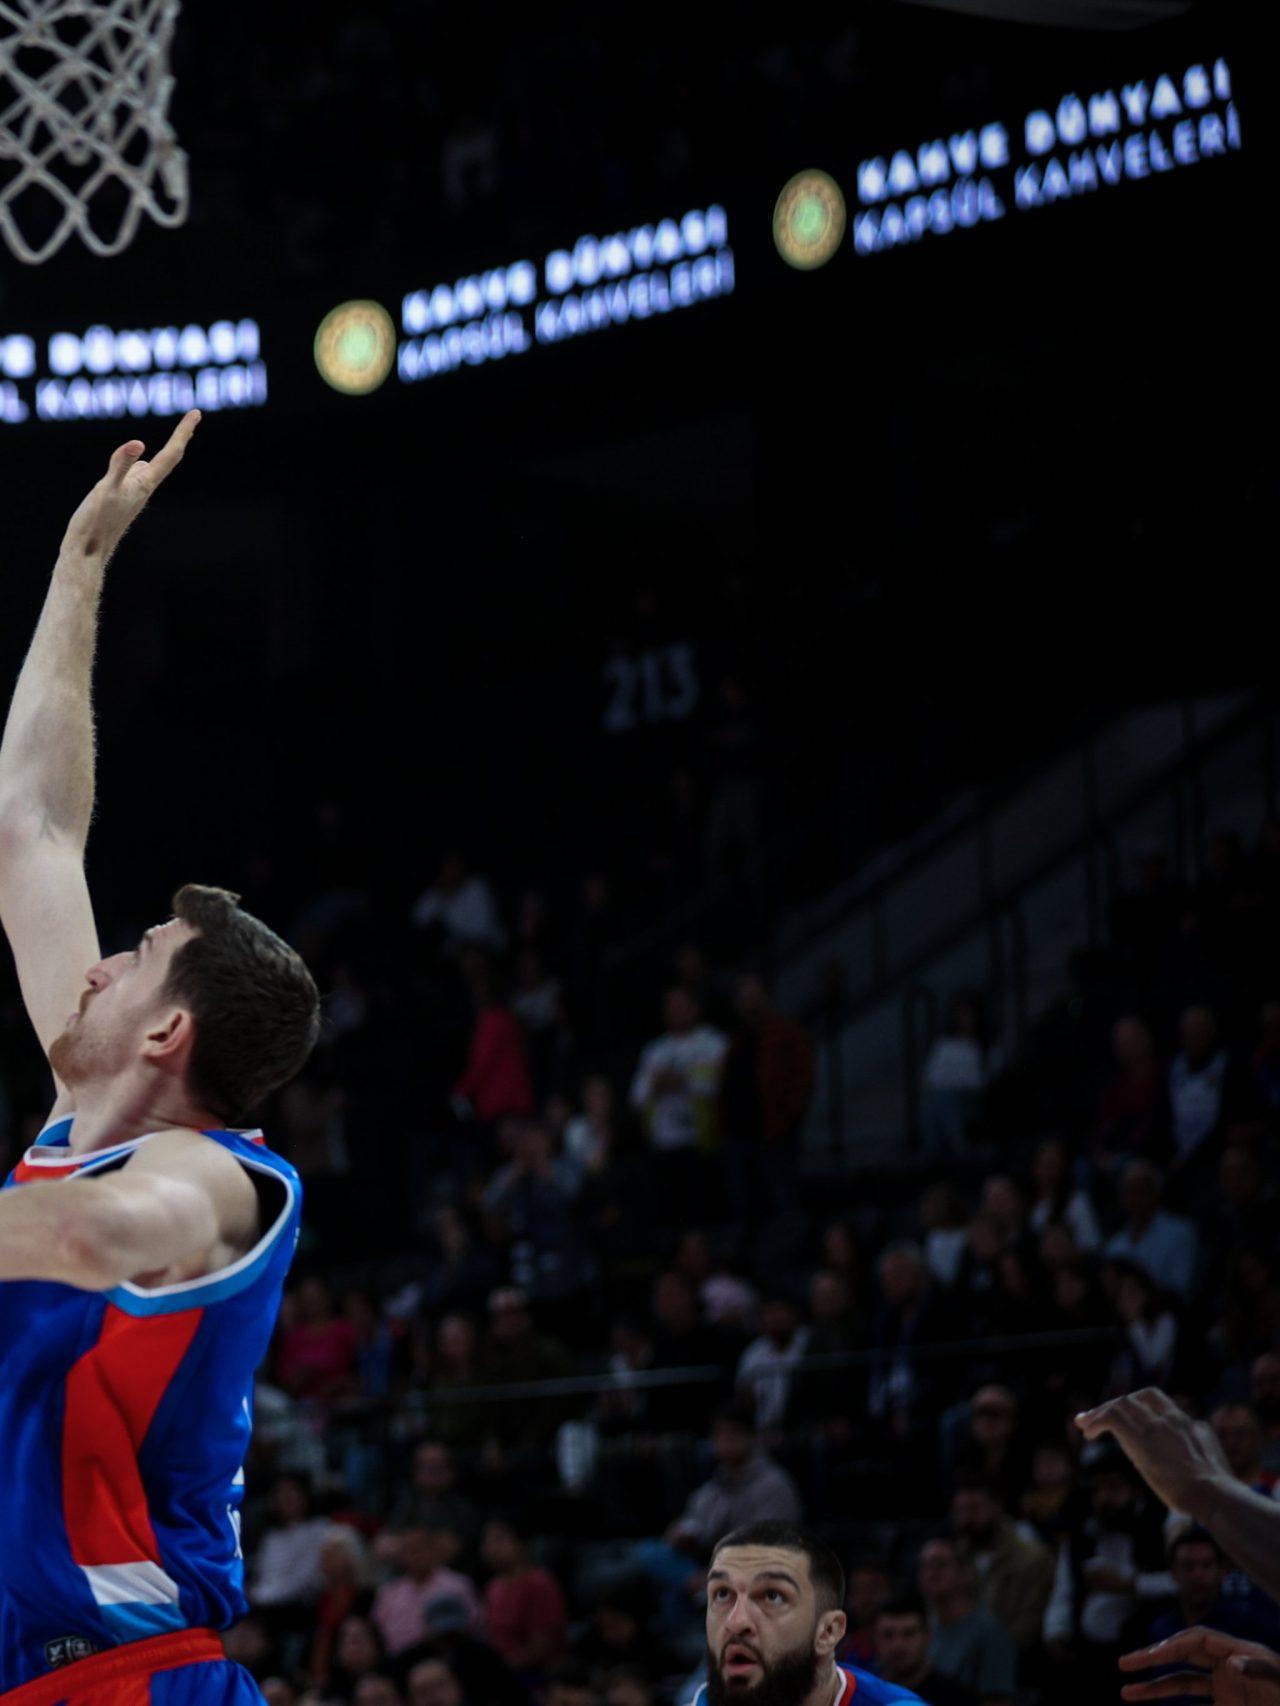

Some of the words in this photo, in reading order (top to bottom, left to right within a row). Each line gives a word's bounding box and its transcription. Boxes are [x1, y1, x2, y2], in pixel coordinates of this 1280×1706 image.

[854, 175, 1005, 256] KAPSÜL
[1014, 100, 1241, 210] KAHVELERİ
[858, 122, 1009, 204] KAHVE
[1024, 57, 1231, 156] DÜNYASI
[397, 309, 532, 384] KAPSÜL
